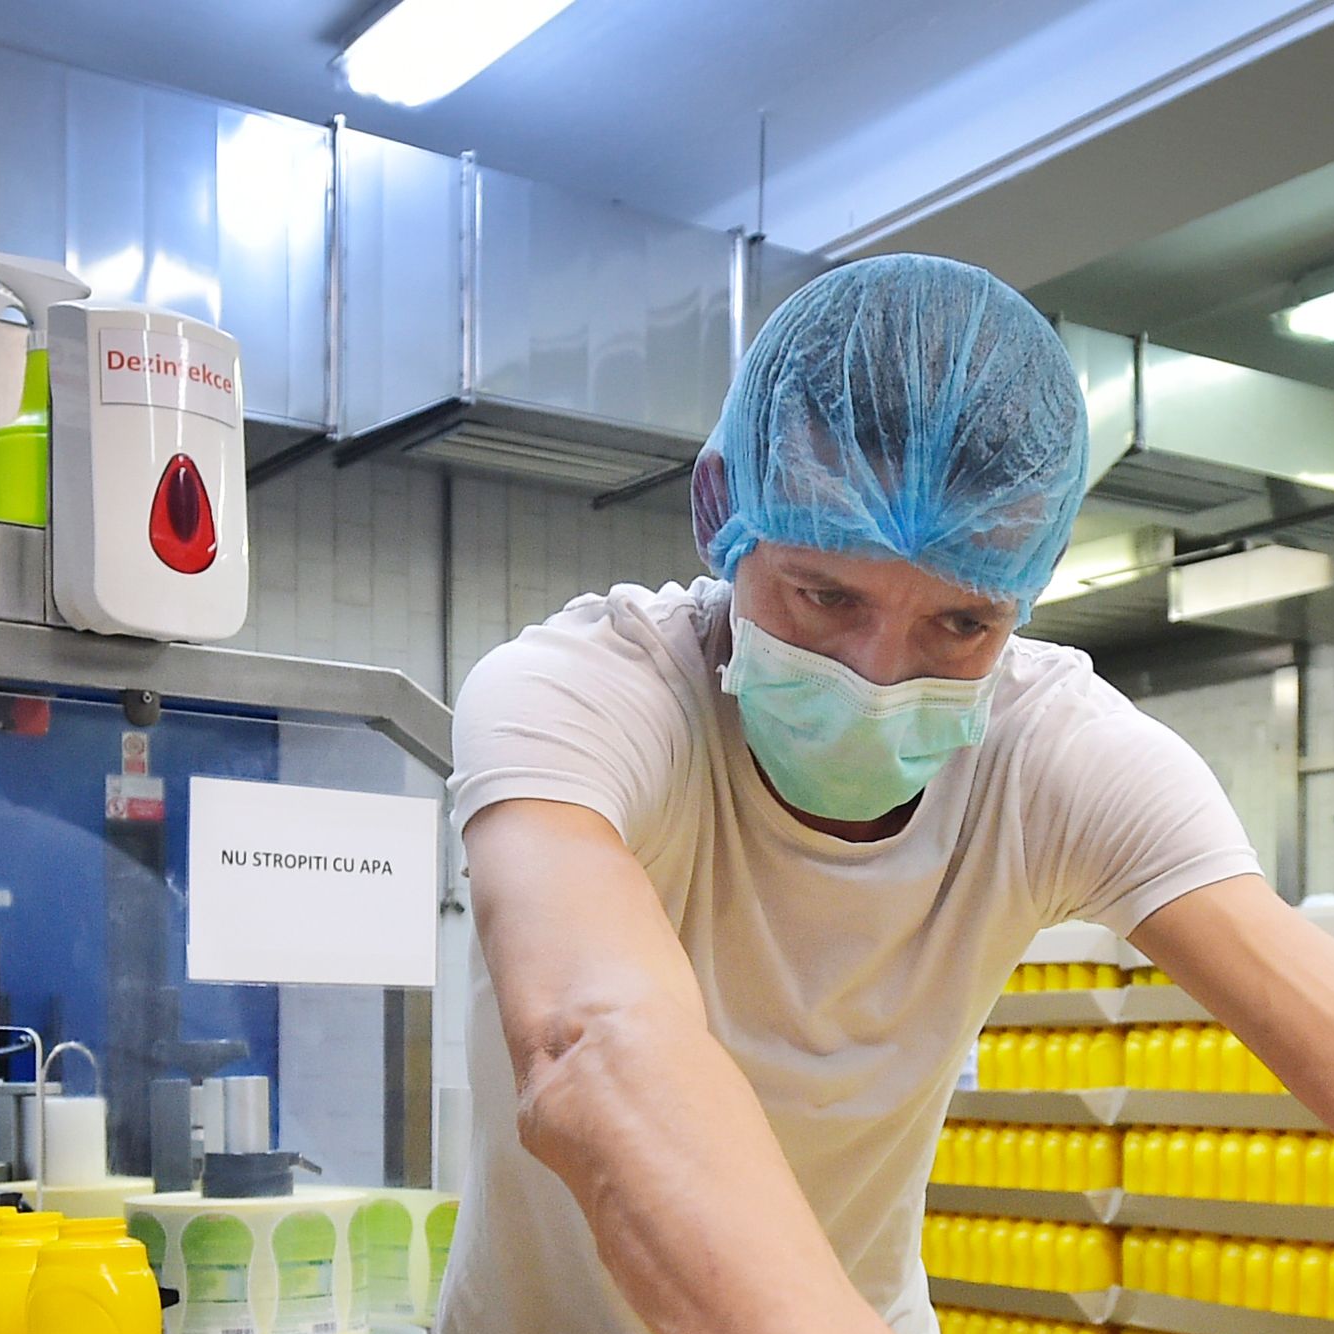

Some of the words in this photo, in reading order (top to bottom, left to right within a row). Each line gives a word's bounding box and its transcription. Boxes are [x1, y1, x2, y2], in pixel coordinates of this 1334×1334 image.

[107, 350, 232, 394] Dezinekce
[221, 850, 247, 866] NU
[252, 852, 328, 872] STROPITI
[333, 857, 354, 873] CU
[360, 859, 393, 876] APA
